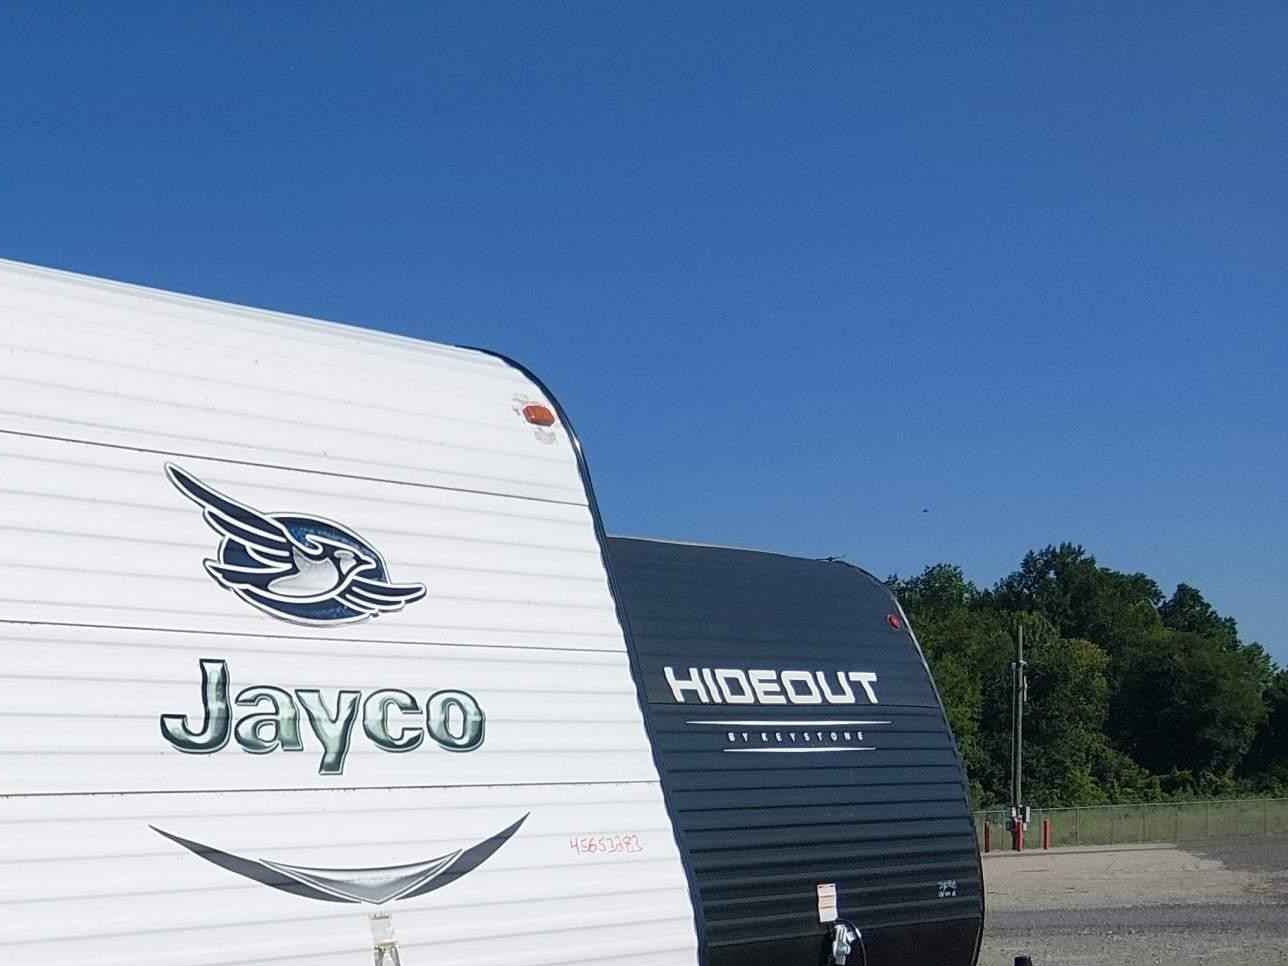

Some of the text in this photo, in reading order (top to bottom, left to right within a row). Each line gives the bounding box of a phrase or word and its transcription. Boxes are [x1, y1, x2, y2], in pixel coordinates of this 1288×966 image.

[663, 666, 879, 705] HIDEOUT
[160, 658, 486, 775] Jayco
[727, 731, 864, 743] BY KEYSTONE
